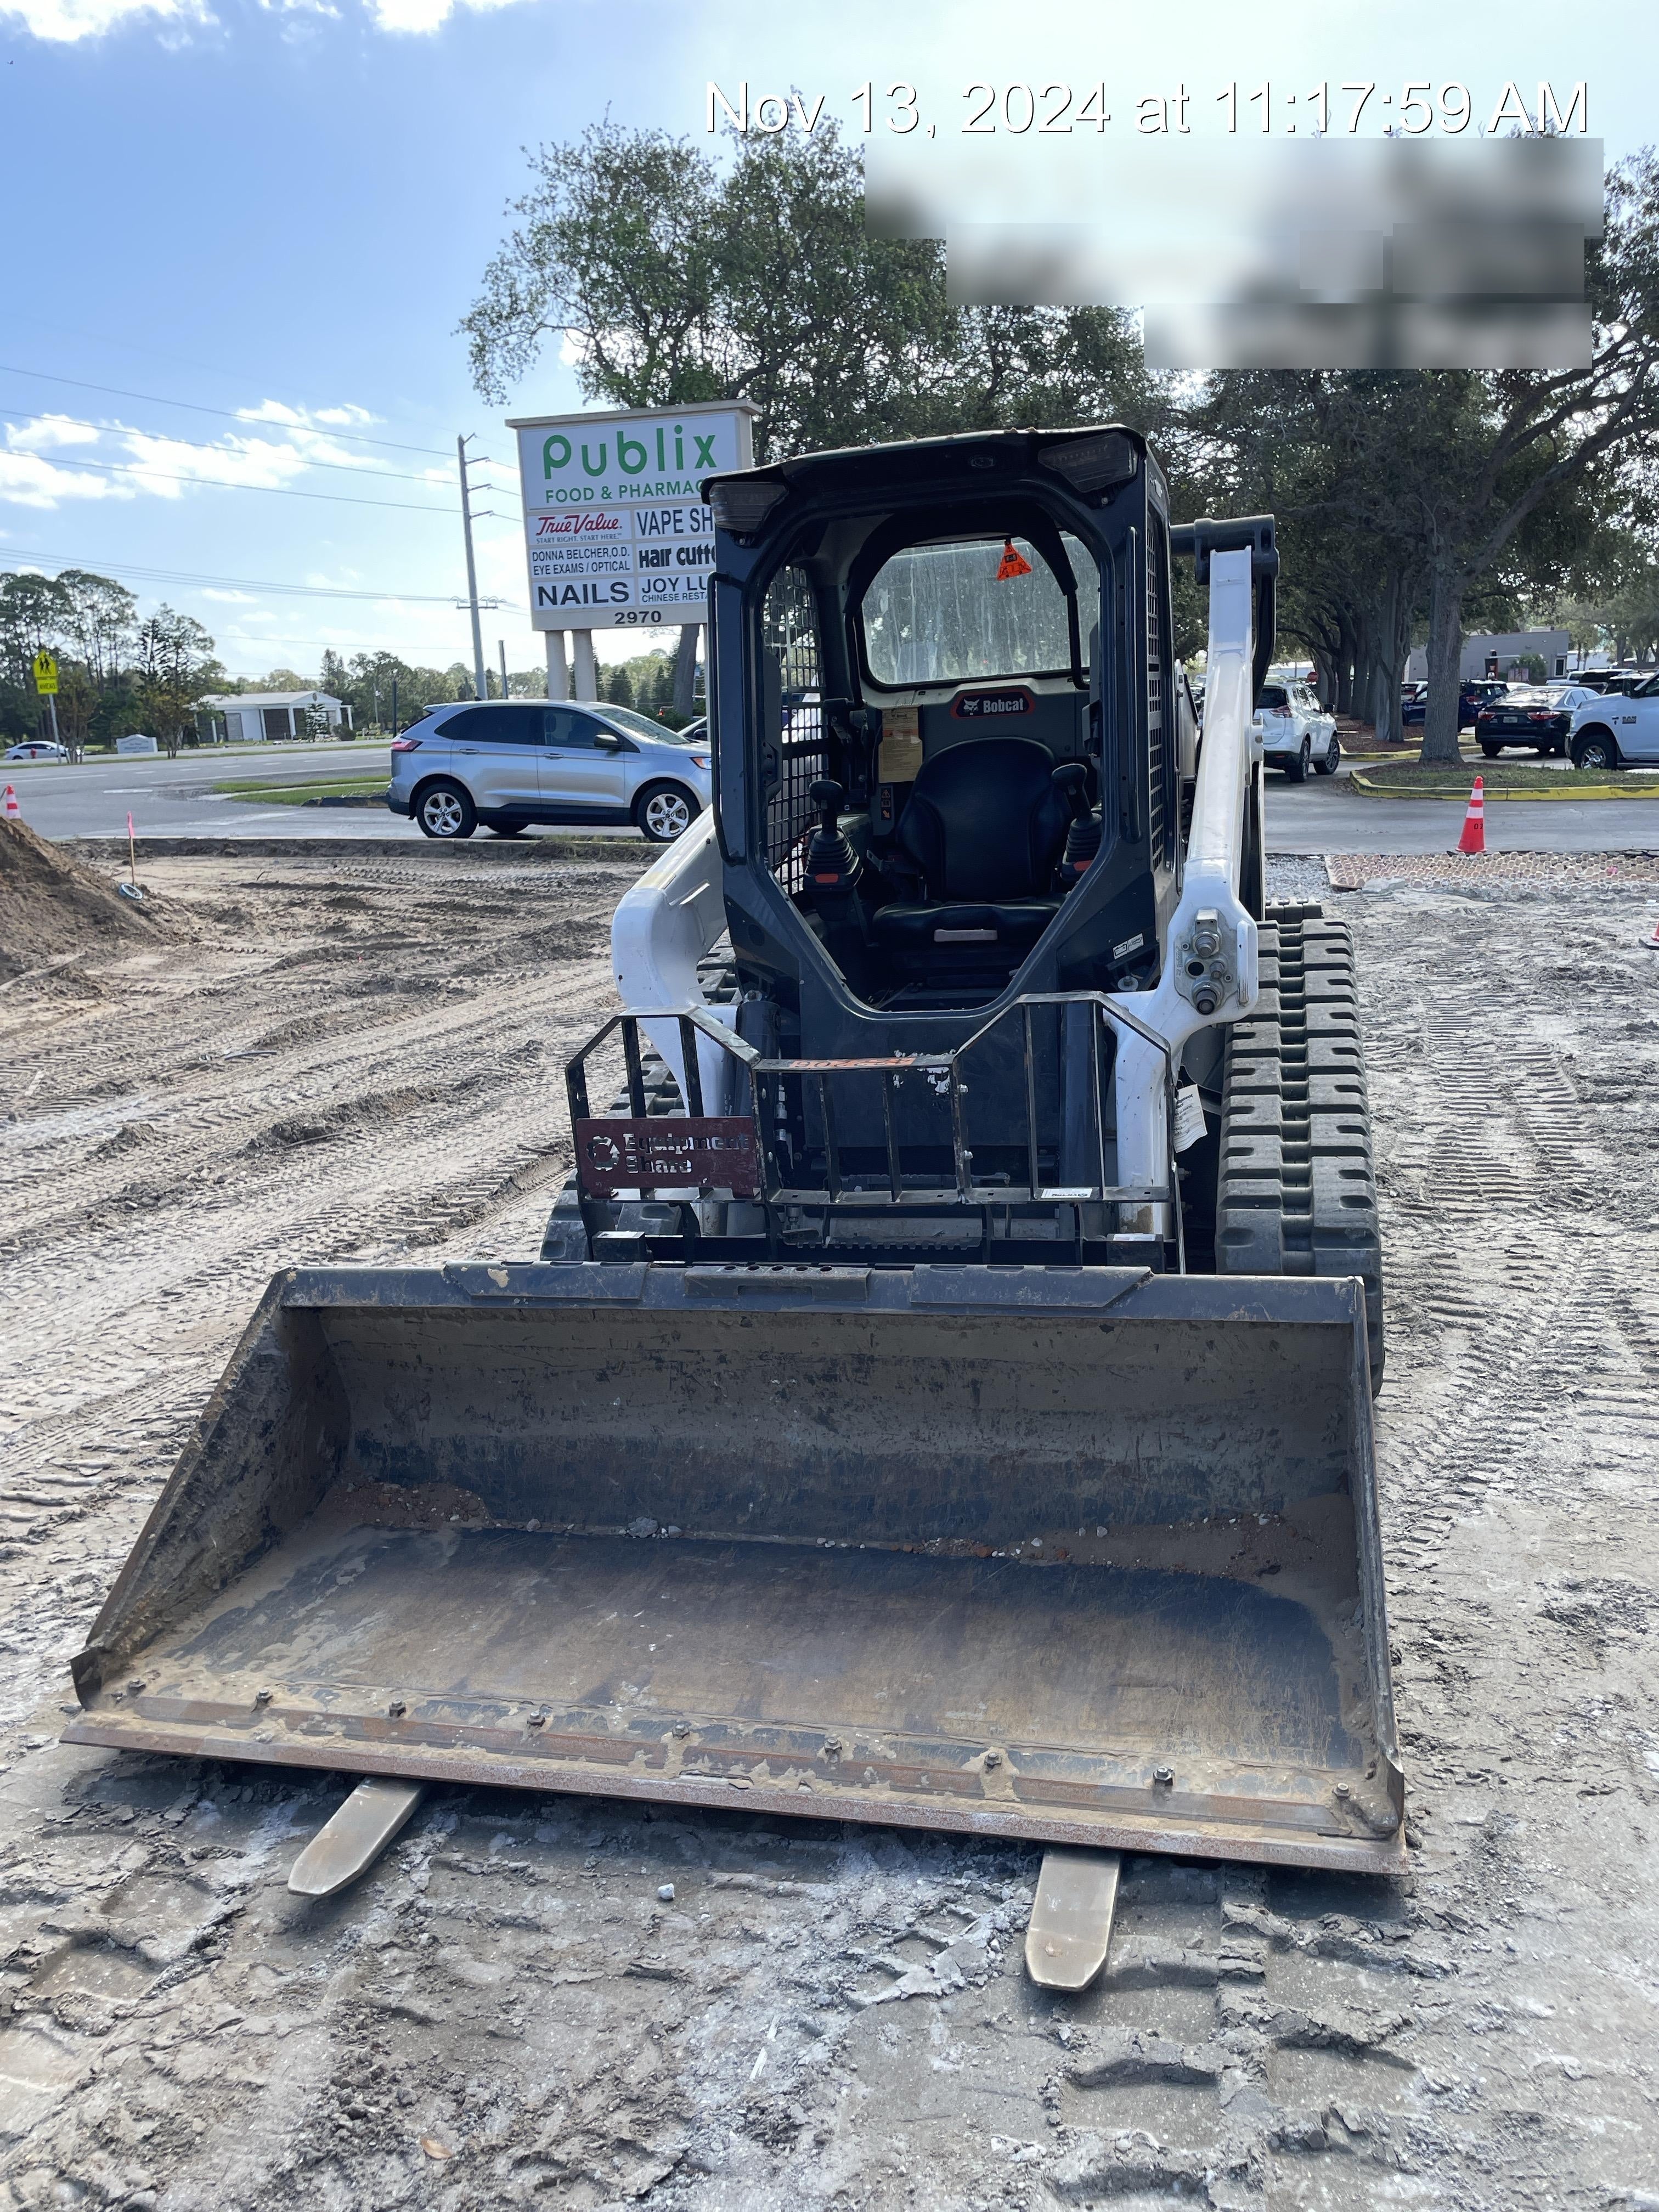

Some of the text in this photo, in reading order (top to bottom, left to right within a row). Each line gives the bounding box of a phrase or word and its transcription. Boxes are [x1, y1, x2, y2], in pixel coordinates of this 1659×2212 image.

[543, 425, 717, 479] Publix
[546, 487, 594, 503] FOOD
[601, 486, 612, 499] &
[636, 507, 714, 536] VAPE SH
[532, 550, 564, 562] DONNA
[639, 548, 672, 568] Hair
[533, 565, 552, 575] EYE
[554, 563, 584, 574] EXAMS
[591, 561, 630, 572] OPTICAL
[538, 582, 629, 606] NAILS
[641, 577, 680, 594] JOY
[642, 591, 707, 603] CHINESE REST
[614, 610, 662, 624] 2970
[983, 698, 1024, 713] Bobcat
[623, 1133, 749, 1155] Equipment
[626, 1155, 692, 1173] Share
